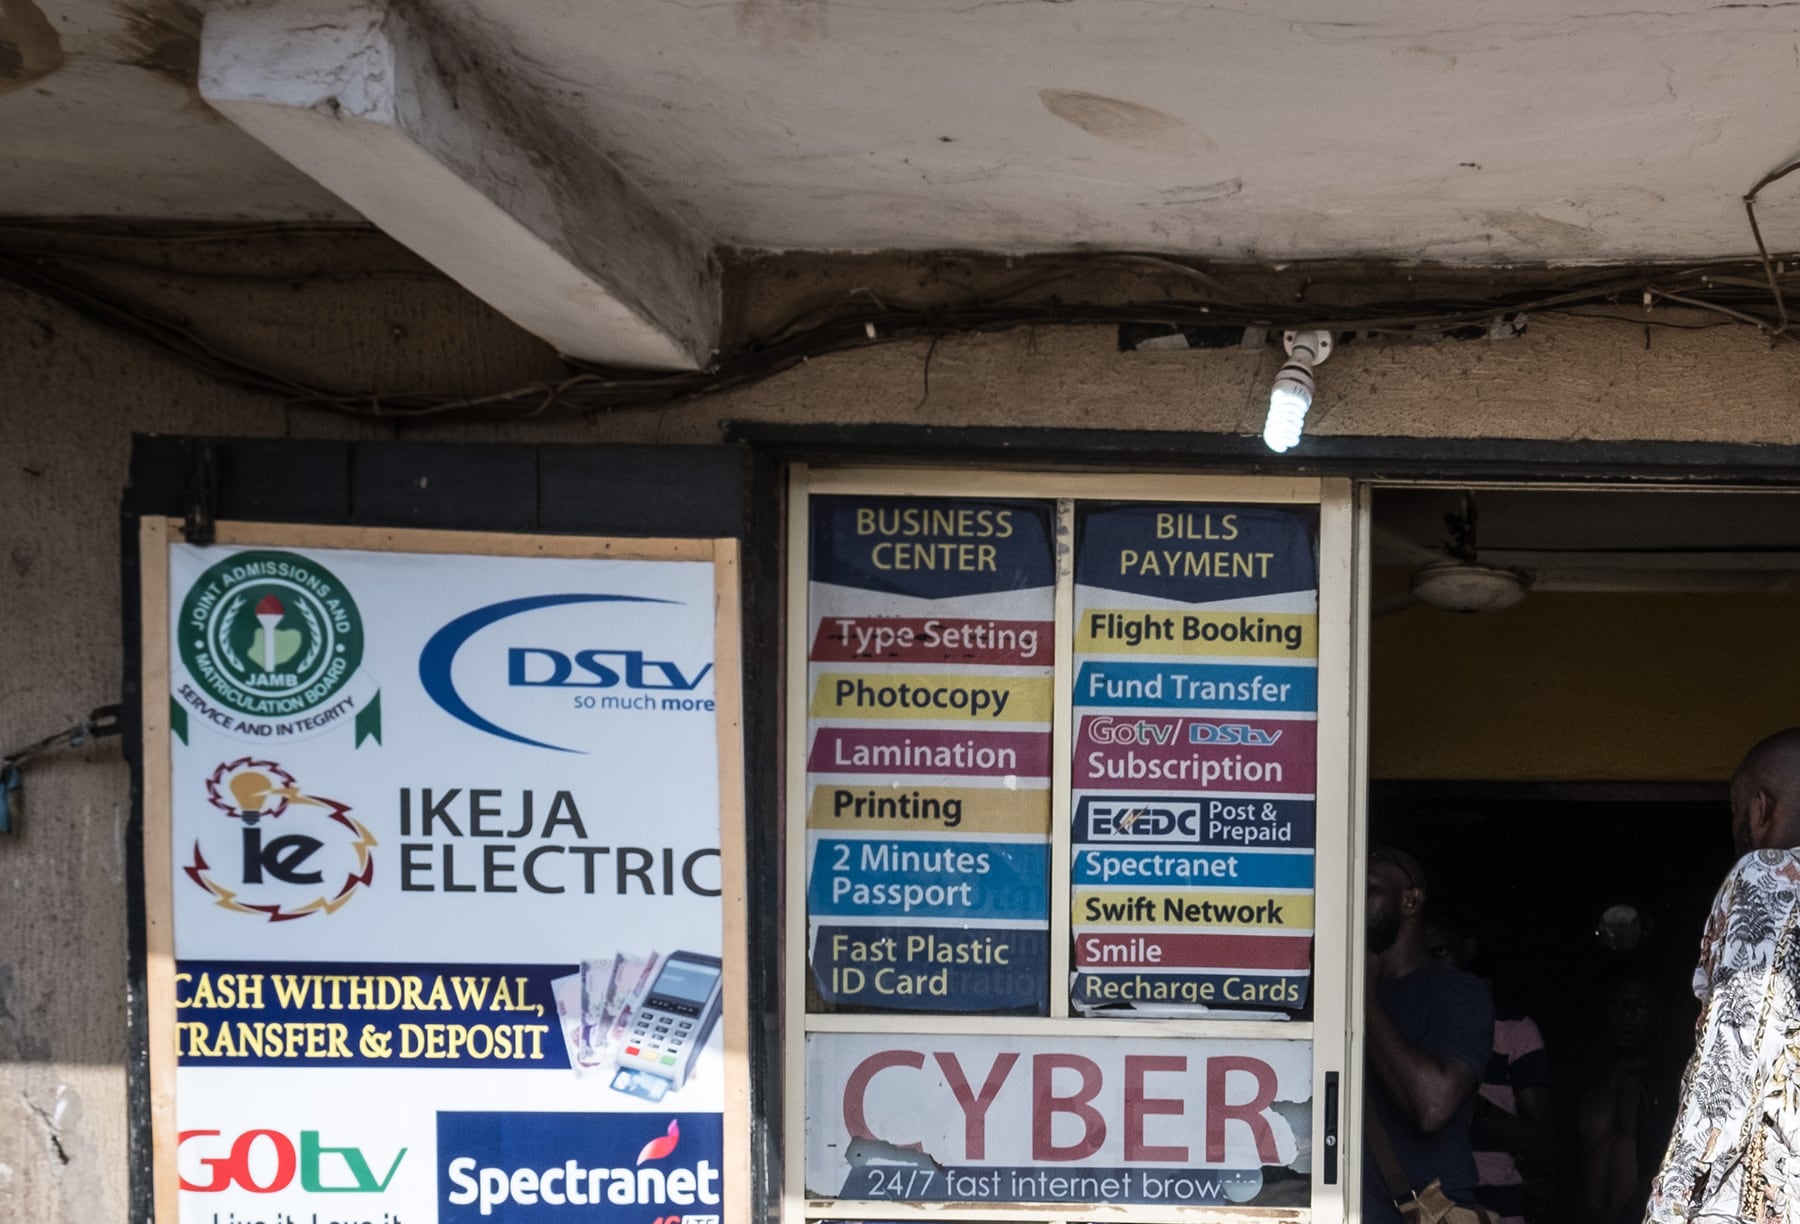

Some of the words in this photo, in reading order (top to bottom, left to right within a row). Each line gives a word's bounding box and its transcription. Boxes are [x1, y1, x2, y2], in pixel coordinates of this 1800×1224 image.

[857, 508, 1013, 538] BUSINESS
[1156, 513, 1238, 540] BILLS
[871, 542, 997, 572] CENTER
[1120, 550, 1275, 579] PAYMENT
[192, 583, 221, 631] JOINT
[222, 562, 331, 598] ADMISSIONS
[326, 598, 351, 633] AND
[836, 619, 918, 655] Type
[922, 620, 1038, 658] Setting
[1090, 614, 1175, 648] Flight
[1181, 616, 1303, 650] Booking
[195, 652, 304, 714] MATRICULATION
[305, 657, 348, 704] BOARD
[245, 673, 299, 687] JAMB
[1089, 673, 1163, 700] Fund
[1170, 675, 1291, 702] Transfer
[178, 684, 234, 729] SERVICE
[234, 721, 273, 737] AND
[574, 696, 595, 710] so
[601, 693, 657, 710] much
[661, 697, 715, 712] more
[836, 679, 1010, 717] Photocopy
[835, 738, 1017, 769] Lamination
[1088, 752, 1283, 786] Subscription
[400, 787, 588, 838] IKEJA
[833, 790, 963, 827] Printing
[1209, 802, 1256, 822] Post
[1261, 803, 1277, 822] &
[1208, 821, 1292, 846] Prepaid
[401, 843, 722, 897] ELECTRIC
[832, 844, 851, 871] 2
[861, 845, 991, 875] Minutes
[1086, 852, 1238, 880] Spectranet
[832, 878, 972, 912] Passport
[1086, 898, 1157, 922] Swift
[1163, 898, 1284, 925] Network
[832, 933, 897, 962] Fast
[907, 934, 1009, 965] Plastic
[1086, 939, 1163, 963] Smile
[175, 972, 265, 1009] CASH
[271, 973, 545, 1017] WITHDRAWAL,
[832, 967, 866, 994] ID
[874, 967, 948, 996] Card
[1086, 976, 1216, 1003] Recharge
[1223, 977, 1300, 1003] Cards
[176, 1021, 354, 1058] TRANSFER
[359, 1024, 393, 1059] &
[399, 1024, 549, 1060] DEPOSIT
[842, 1049, 1282, 1164] CYBER
[448, 1156, 720, 1216] Spectranet
[867, 1169, 935, 1198] 24/7
[945, 1169, 1002, 1198] fast
[1011, 1168, 1135, 1200] internet
